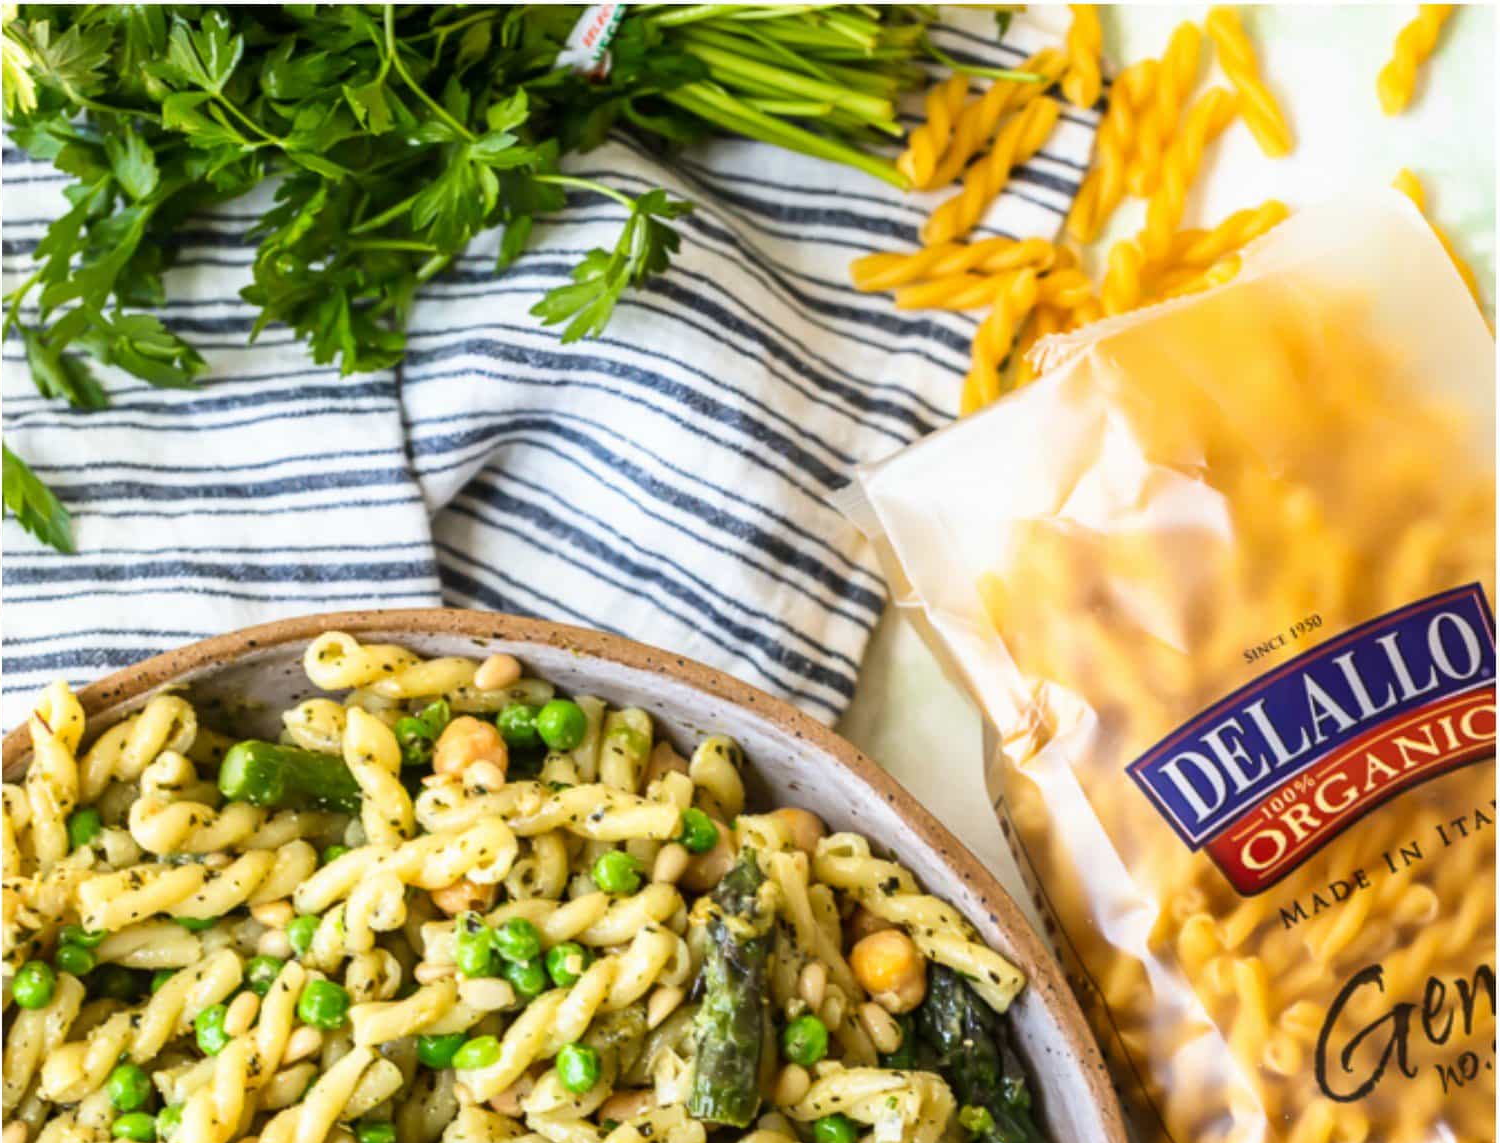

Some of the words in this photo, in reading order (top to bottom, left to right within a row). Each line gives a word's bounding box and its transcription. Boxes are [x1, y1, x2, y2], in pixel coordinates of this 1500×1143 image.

[1243, 633, 1286, 664] SINCE
[1289, 613, 1323, 639] 1950
[1158, 612, 1481, 823] DELALLO
[1261, 774, 1317, 820] 100%
[1279, 868, 1372, 929] MADE
[1382, 841, 1424, 874] IN
[1436, 799, 1496, 847] ITA
